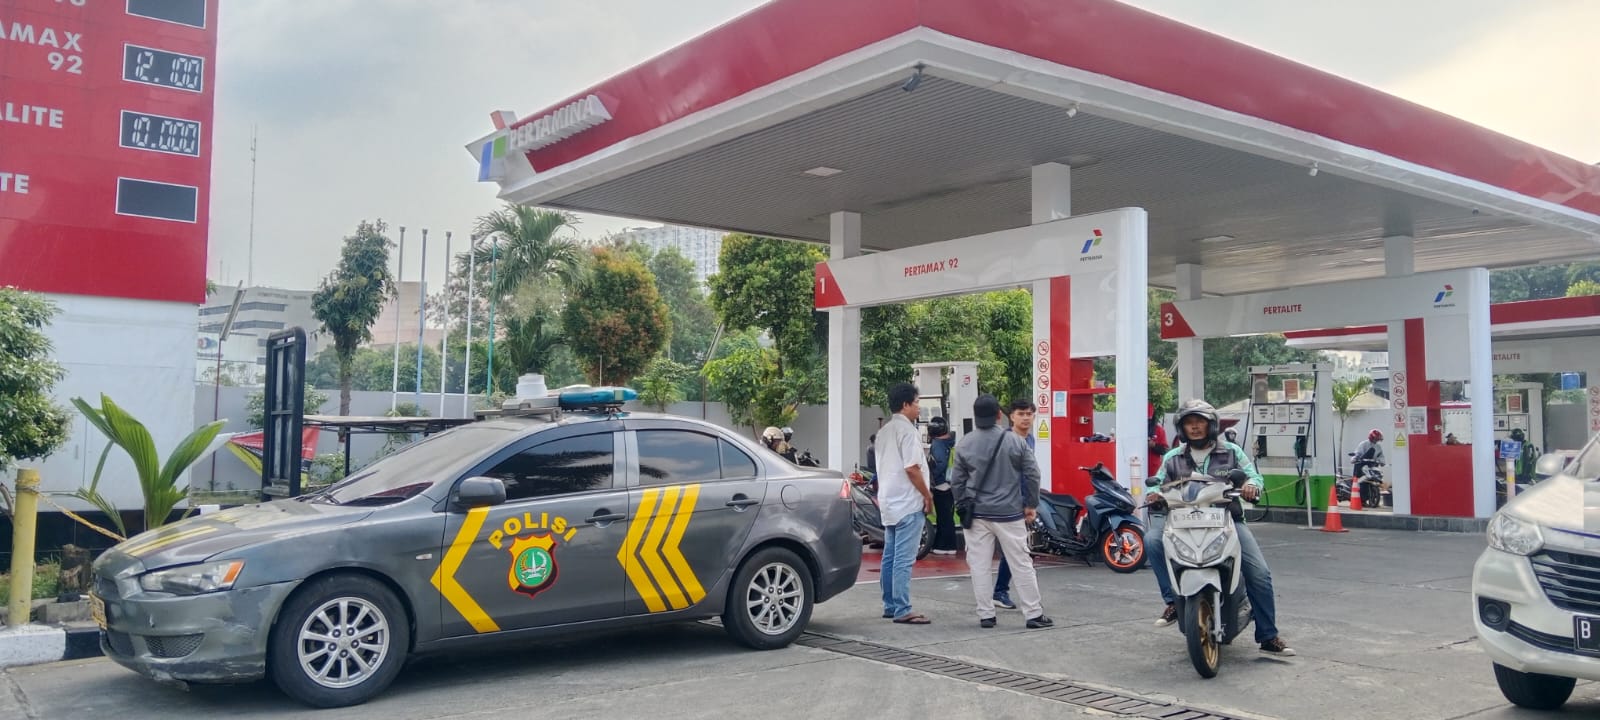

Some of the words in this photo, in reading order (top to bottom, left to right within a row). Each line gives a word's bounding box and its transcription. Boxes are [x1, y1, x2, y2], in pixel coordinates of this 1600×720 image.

[48, 52, 83, 75] 92
[135, 51, 200, 89] 12.100
[0, 102, 64, 128] LITE
[509, 95, 612, 153] PERTAMINA
[132, 116, 197, 153] 10.000
[904, 260, 945, 277] PERTAMAX
[948, 257, 959, 269] 92
[819, 277, 825, 294] 1
[1164, 312, 1174, 327] 3
[1263, 304, 1302, 315] PERTALITE
[1492, 353, 1521, 361] RTALITE
[488, 512, 577, 550] POLISI
[1581, 620, 1591, 639] B
